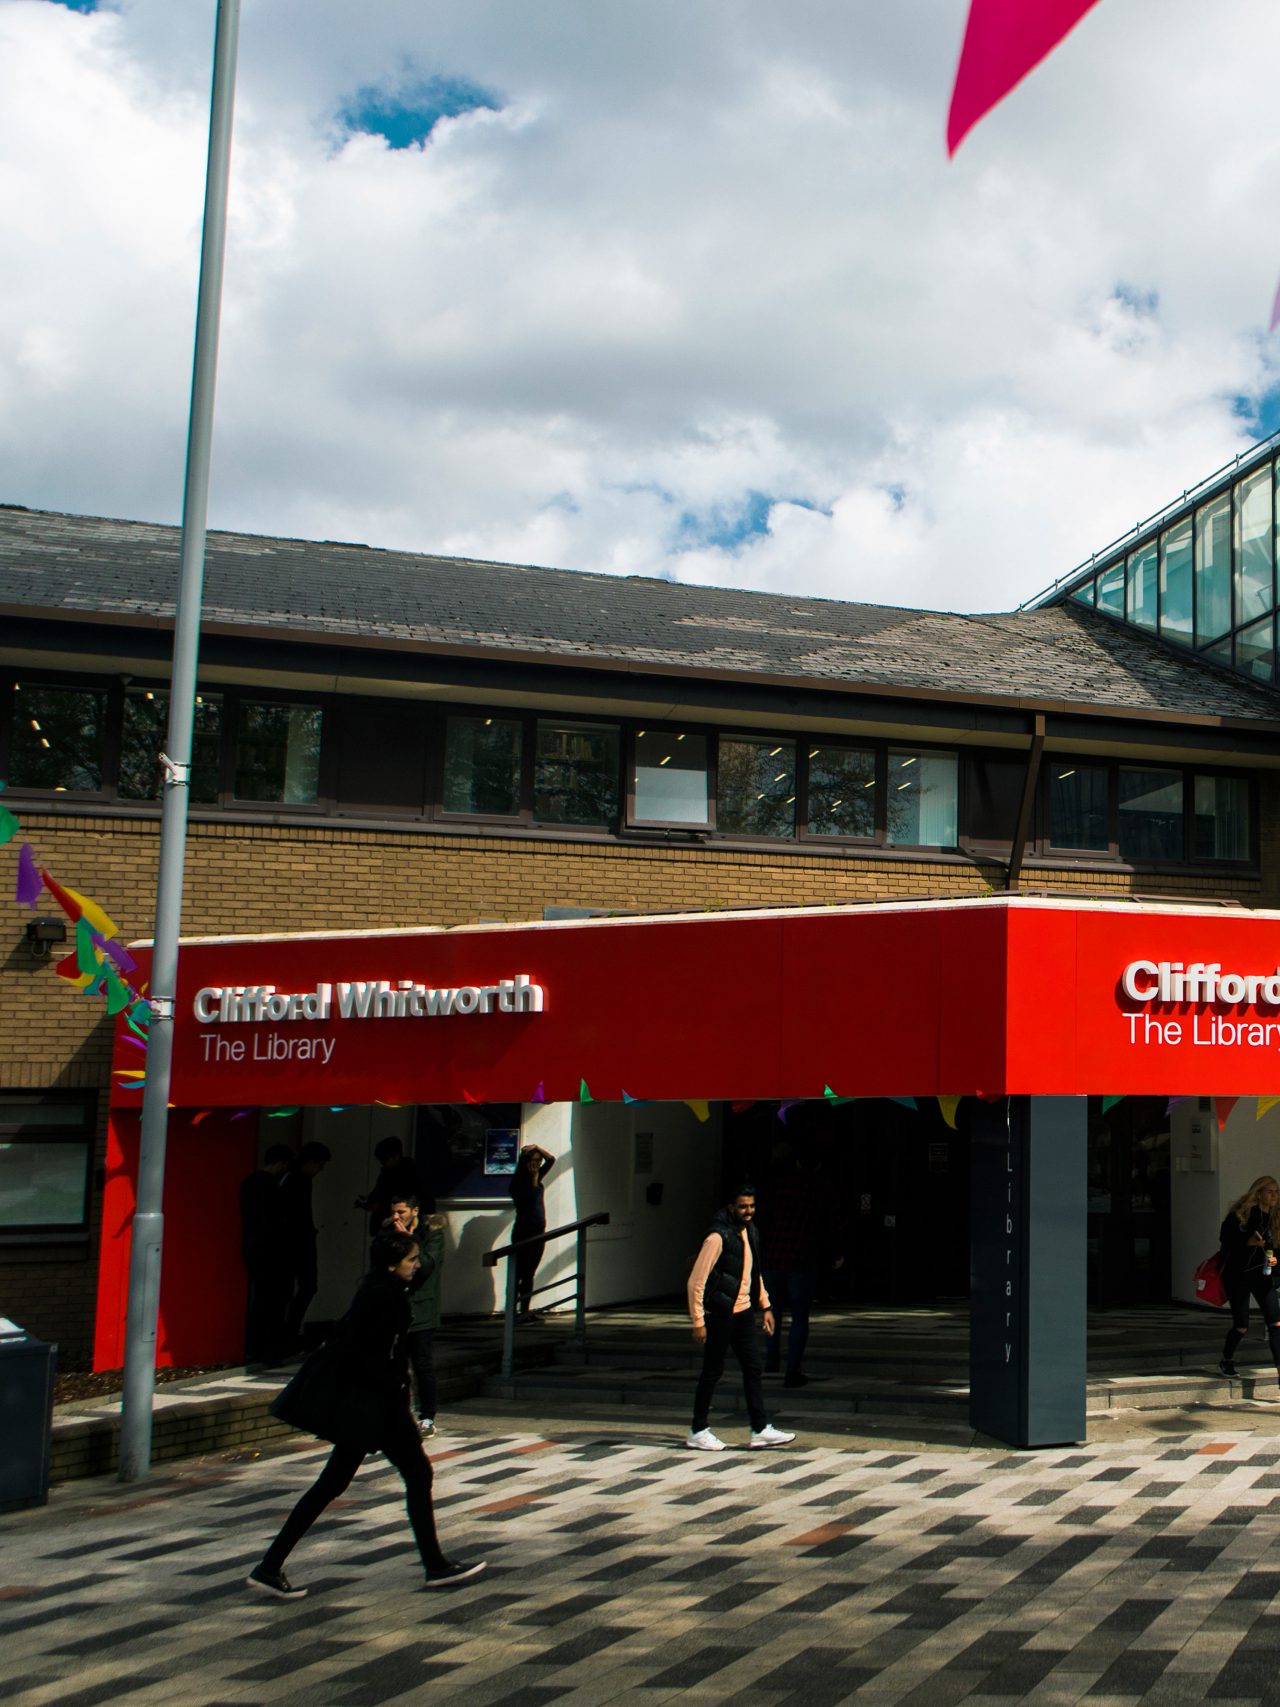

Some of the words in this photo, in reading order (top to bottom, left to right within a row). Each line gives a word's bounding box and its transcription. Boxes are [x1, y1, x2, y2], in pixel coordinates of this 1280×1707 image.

[193, 983, 332, 1024] Clifford
[337, 974, 544, 1019] Whitworth
[1122, 1013, 1182, 1045] The
[200, 1034, 246, 1061] The
[253, 1032, 336, 1064] Library
